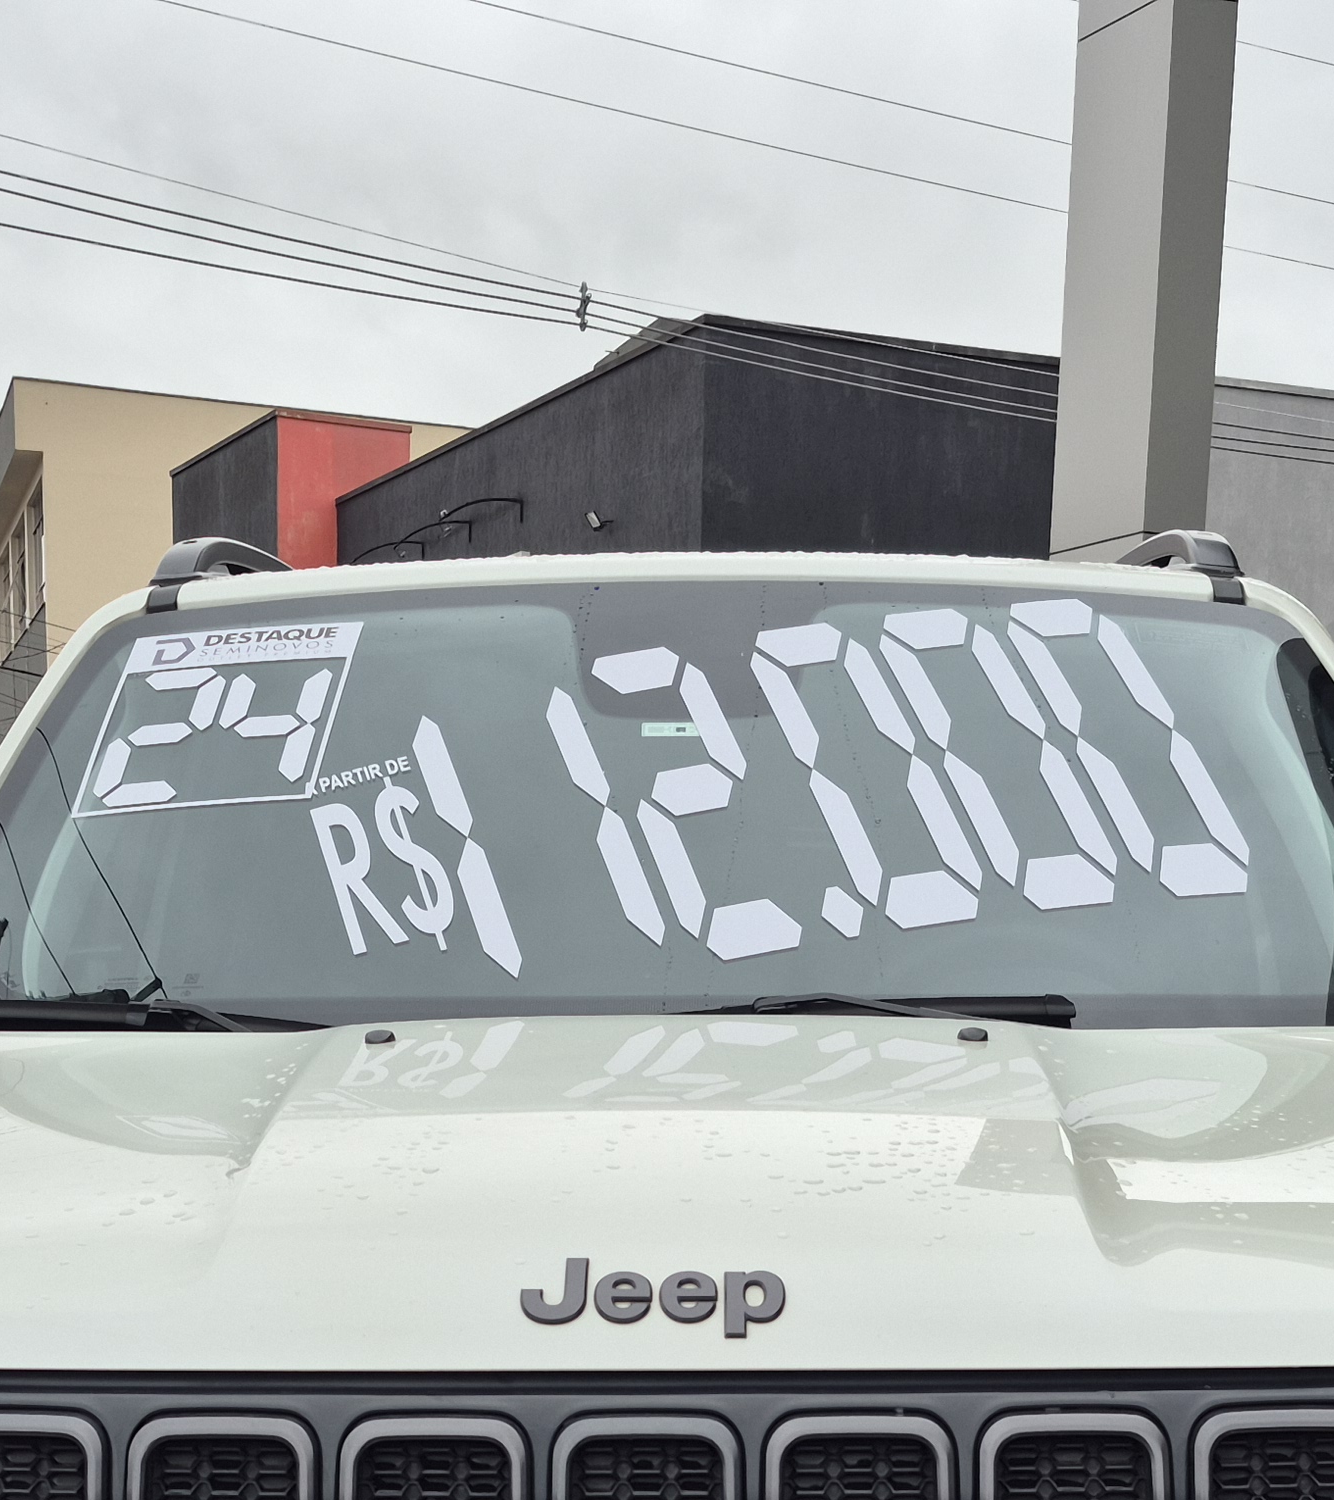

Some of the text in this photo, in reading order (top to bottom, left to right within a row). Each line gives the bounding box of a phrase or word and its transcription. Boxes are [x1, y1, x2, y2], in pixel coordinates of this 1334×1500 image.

[199, 640, 334, 657] SEMINOVOS
[203, 627, 340, 647] DESTAQUE
[93, 667, 334, 807] 24
[318, 763, 384, 793] PARTIR
[384, 755, 412, 777] DE
[520, 1257, 786, 1339] Jeep
